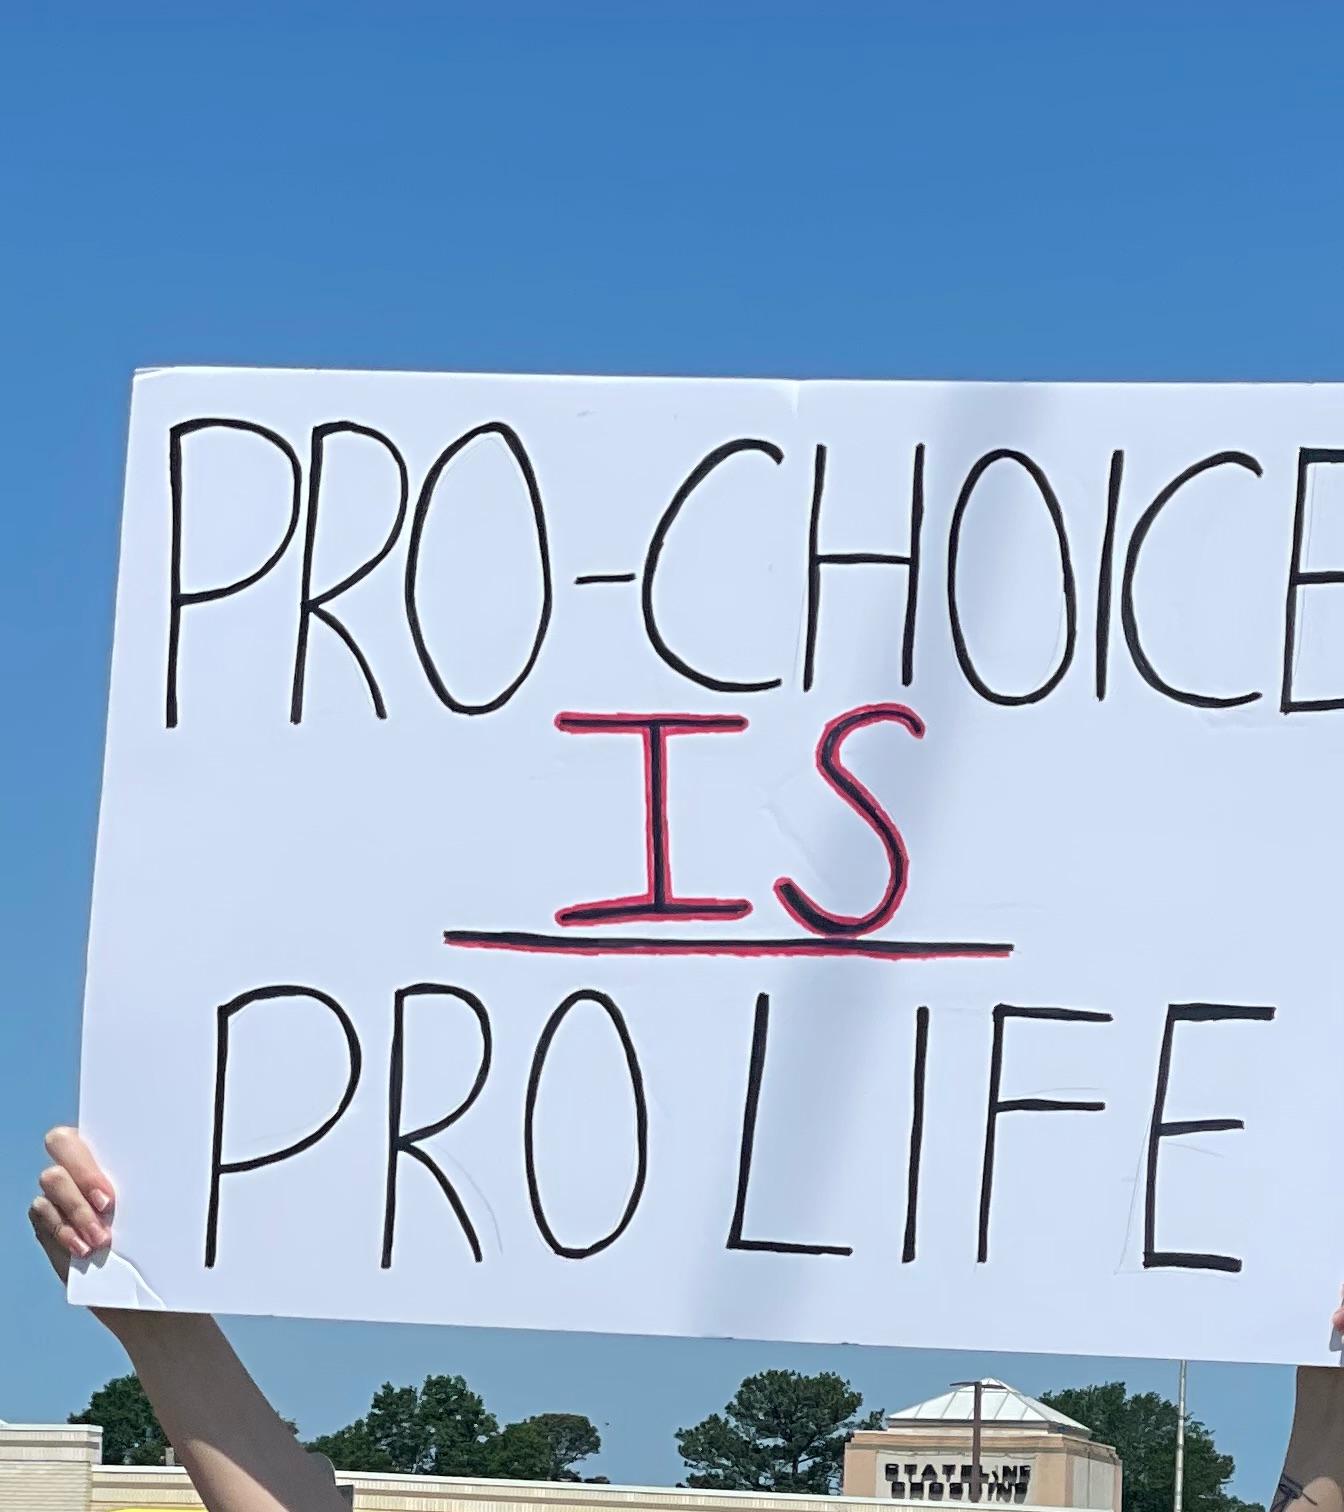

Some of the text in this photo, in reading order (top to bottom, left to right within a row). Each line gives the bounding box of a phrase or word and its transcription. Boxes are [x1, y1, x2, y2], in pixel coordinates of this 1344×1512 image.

[553, 702, 927, 940] IS
[204, 982, 1277, 1275] PRO LIFE
